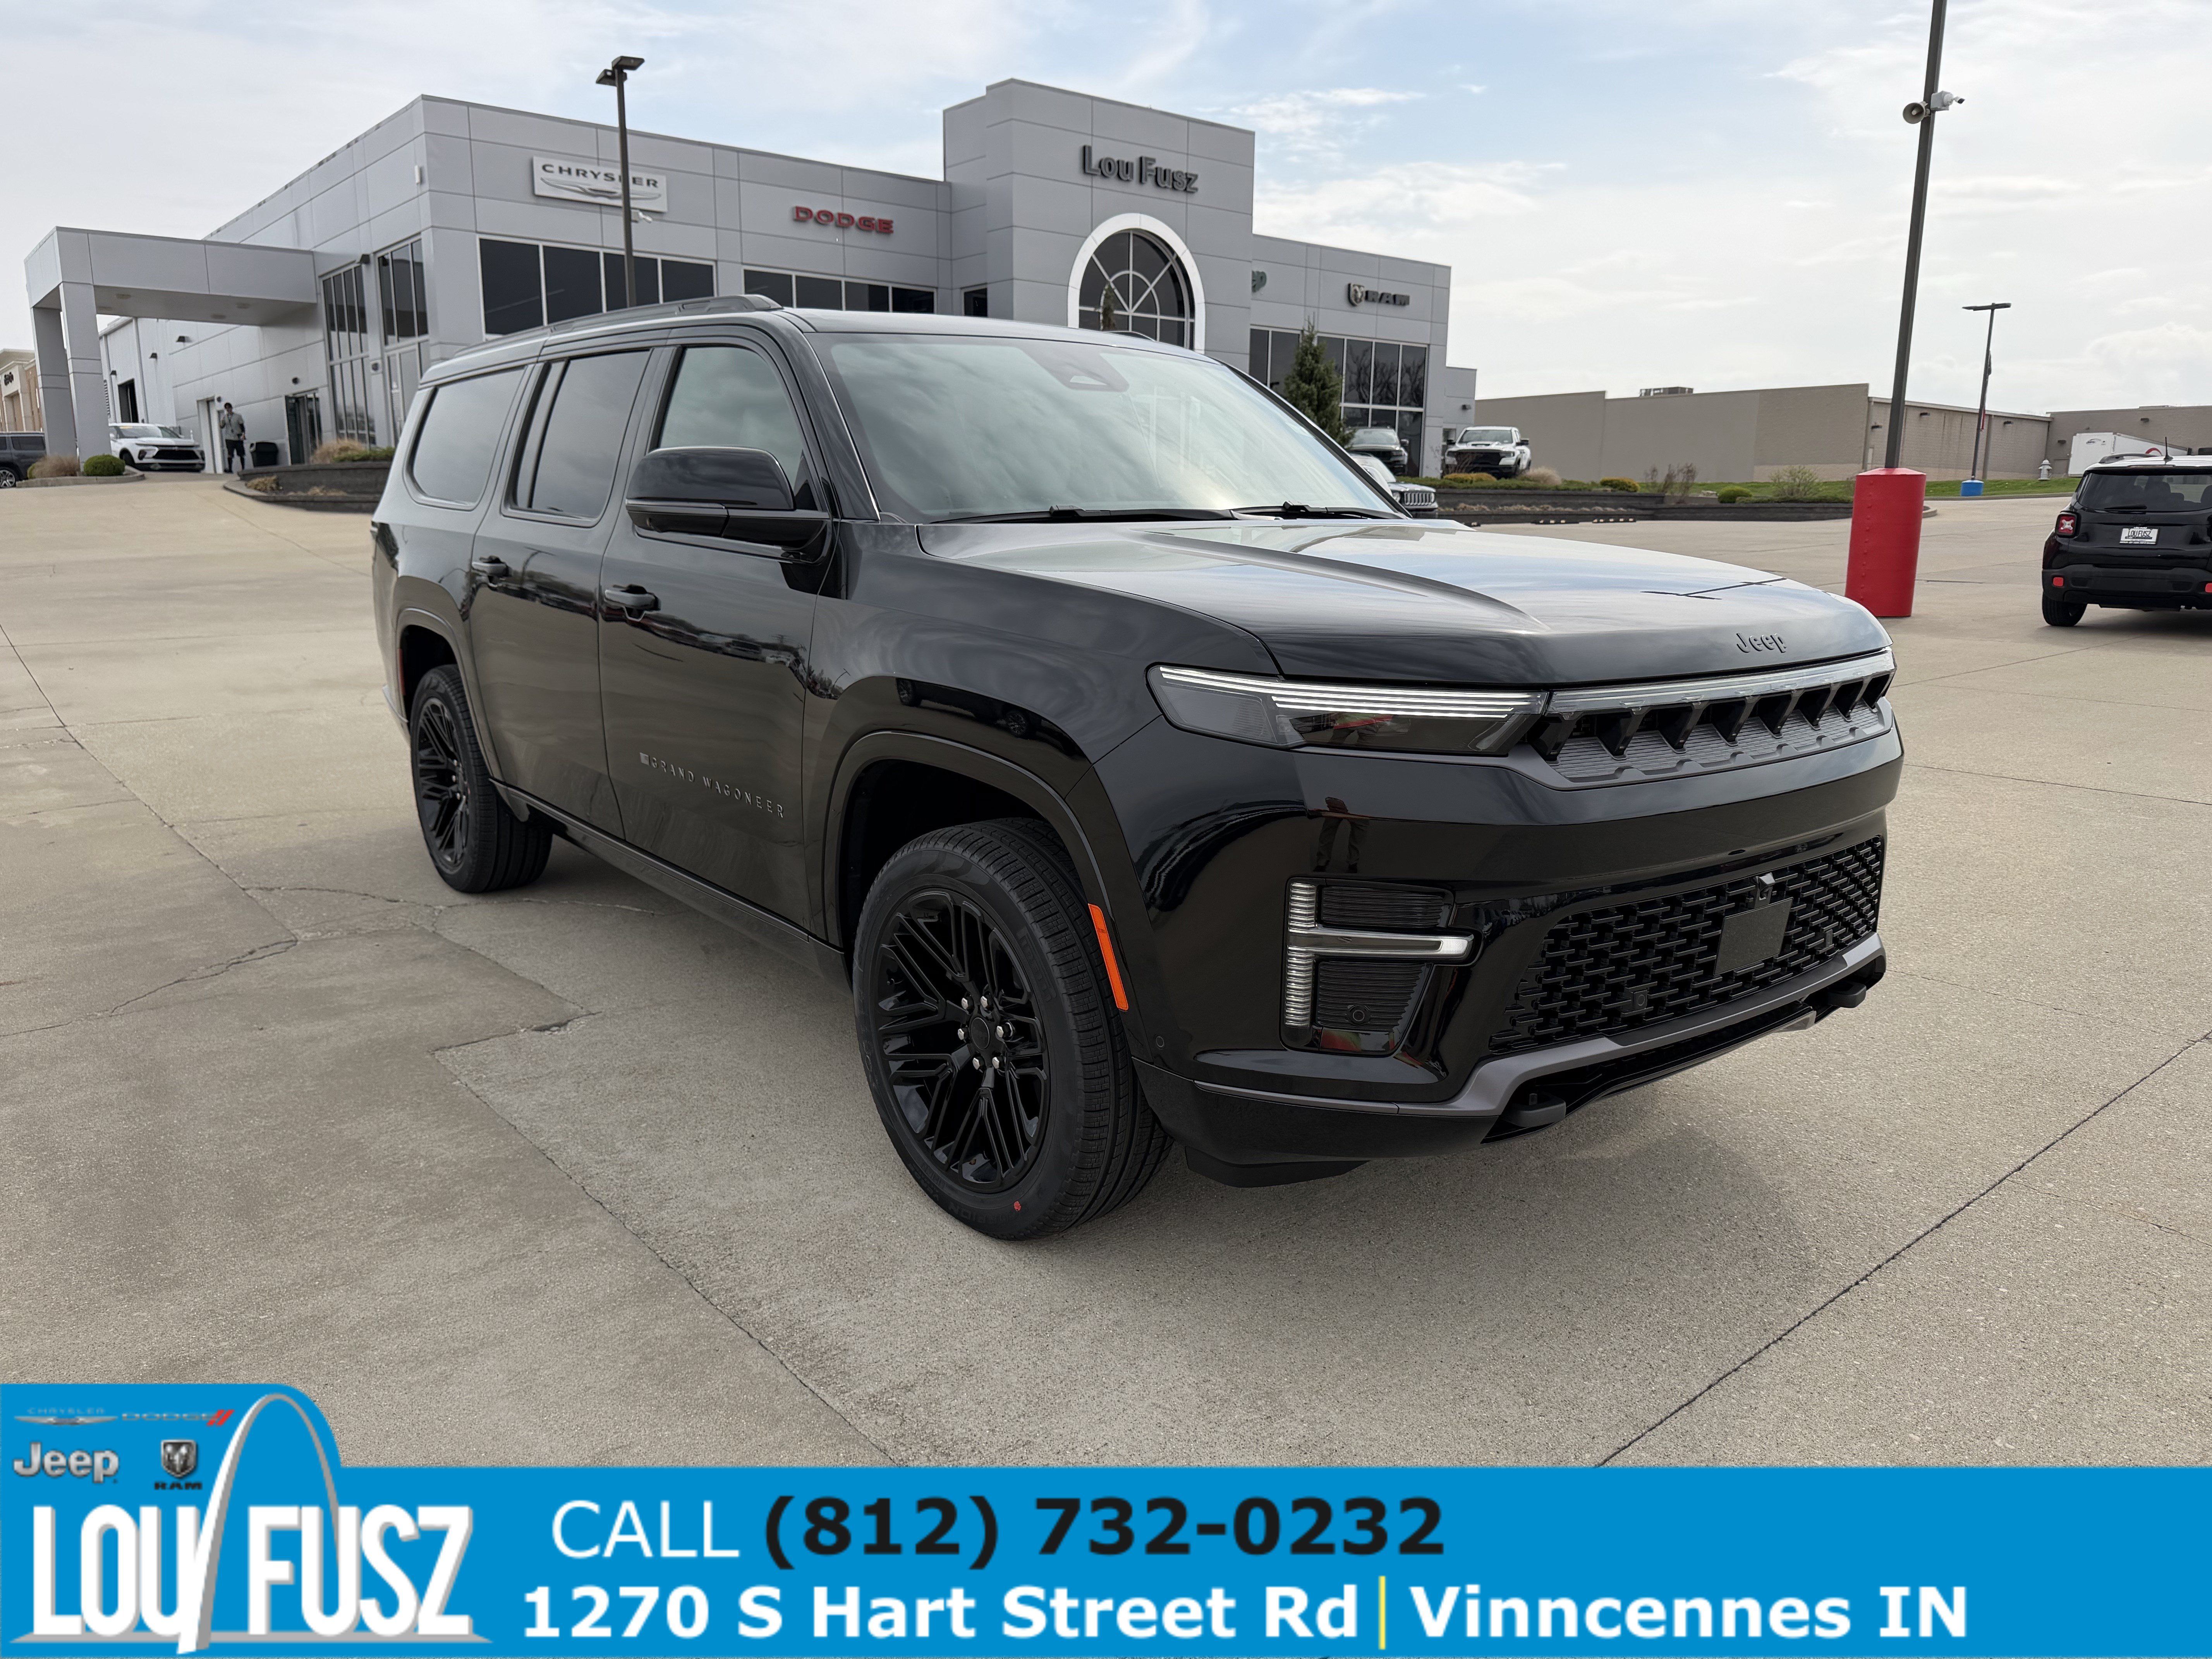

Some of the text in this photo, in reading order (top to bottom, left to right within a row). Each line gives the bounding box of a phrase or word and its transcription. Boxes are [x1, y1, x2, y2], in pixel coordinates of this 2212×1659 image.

[1083, 144, 1198, 194] Lou Fusz
[794, 205, 894, 234] DODGE
[1365, 290, 1410, 306] RAM
[1736, 632, 1786, 653] Jeep
[652, 757, 784, 818] GRAND WAGONEER
